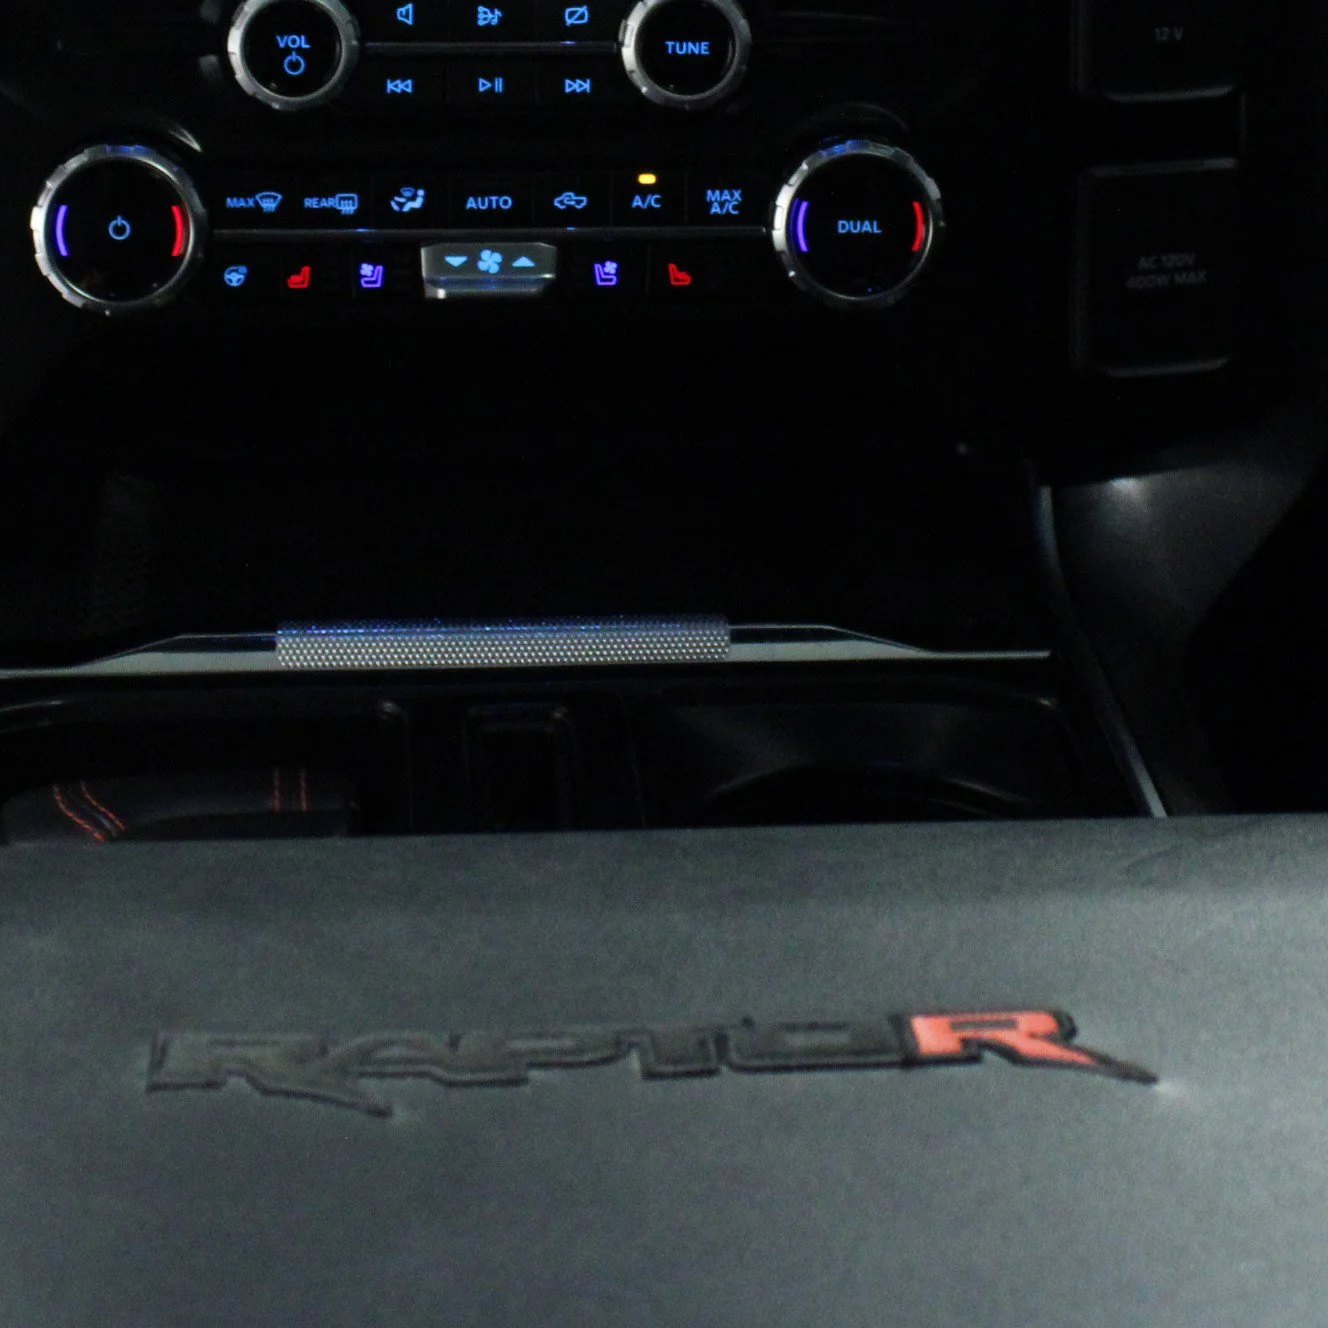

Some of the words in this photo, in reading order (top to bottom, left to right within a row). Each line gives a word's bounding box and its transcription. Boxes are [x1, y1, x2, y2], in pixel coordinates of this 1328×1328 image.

[276, 34, 311, 49] VOL
[664, 40, 710, 55] TUNE
[704, 185, 746, 202] MAX
[226, 195, 257, 208] MAX
[303, 196, 335, 209] REAR
[465, 195, 513, 210] AUTO
[631, 194, 661, 209] A/C
[708, 201, 742, 217] A/C
[837, 219, 882, 234] DUAL
[147, 1008, 1159, 1116] RAPTOR
